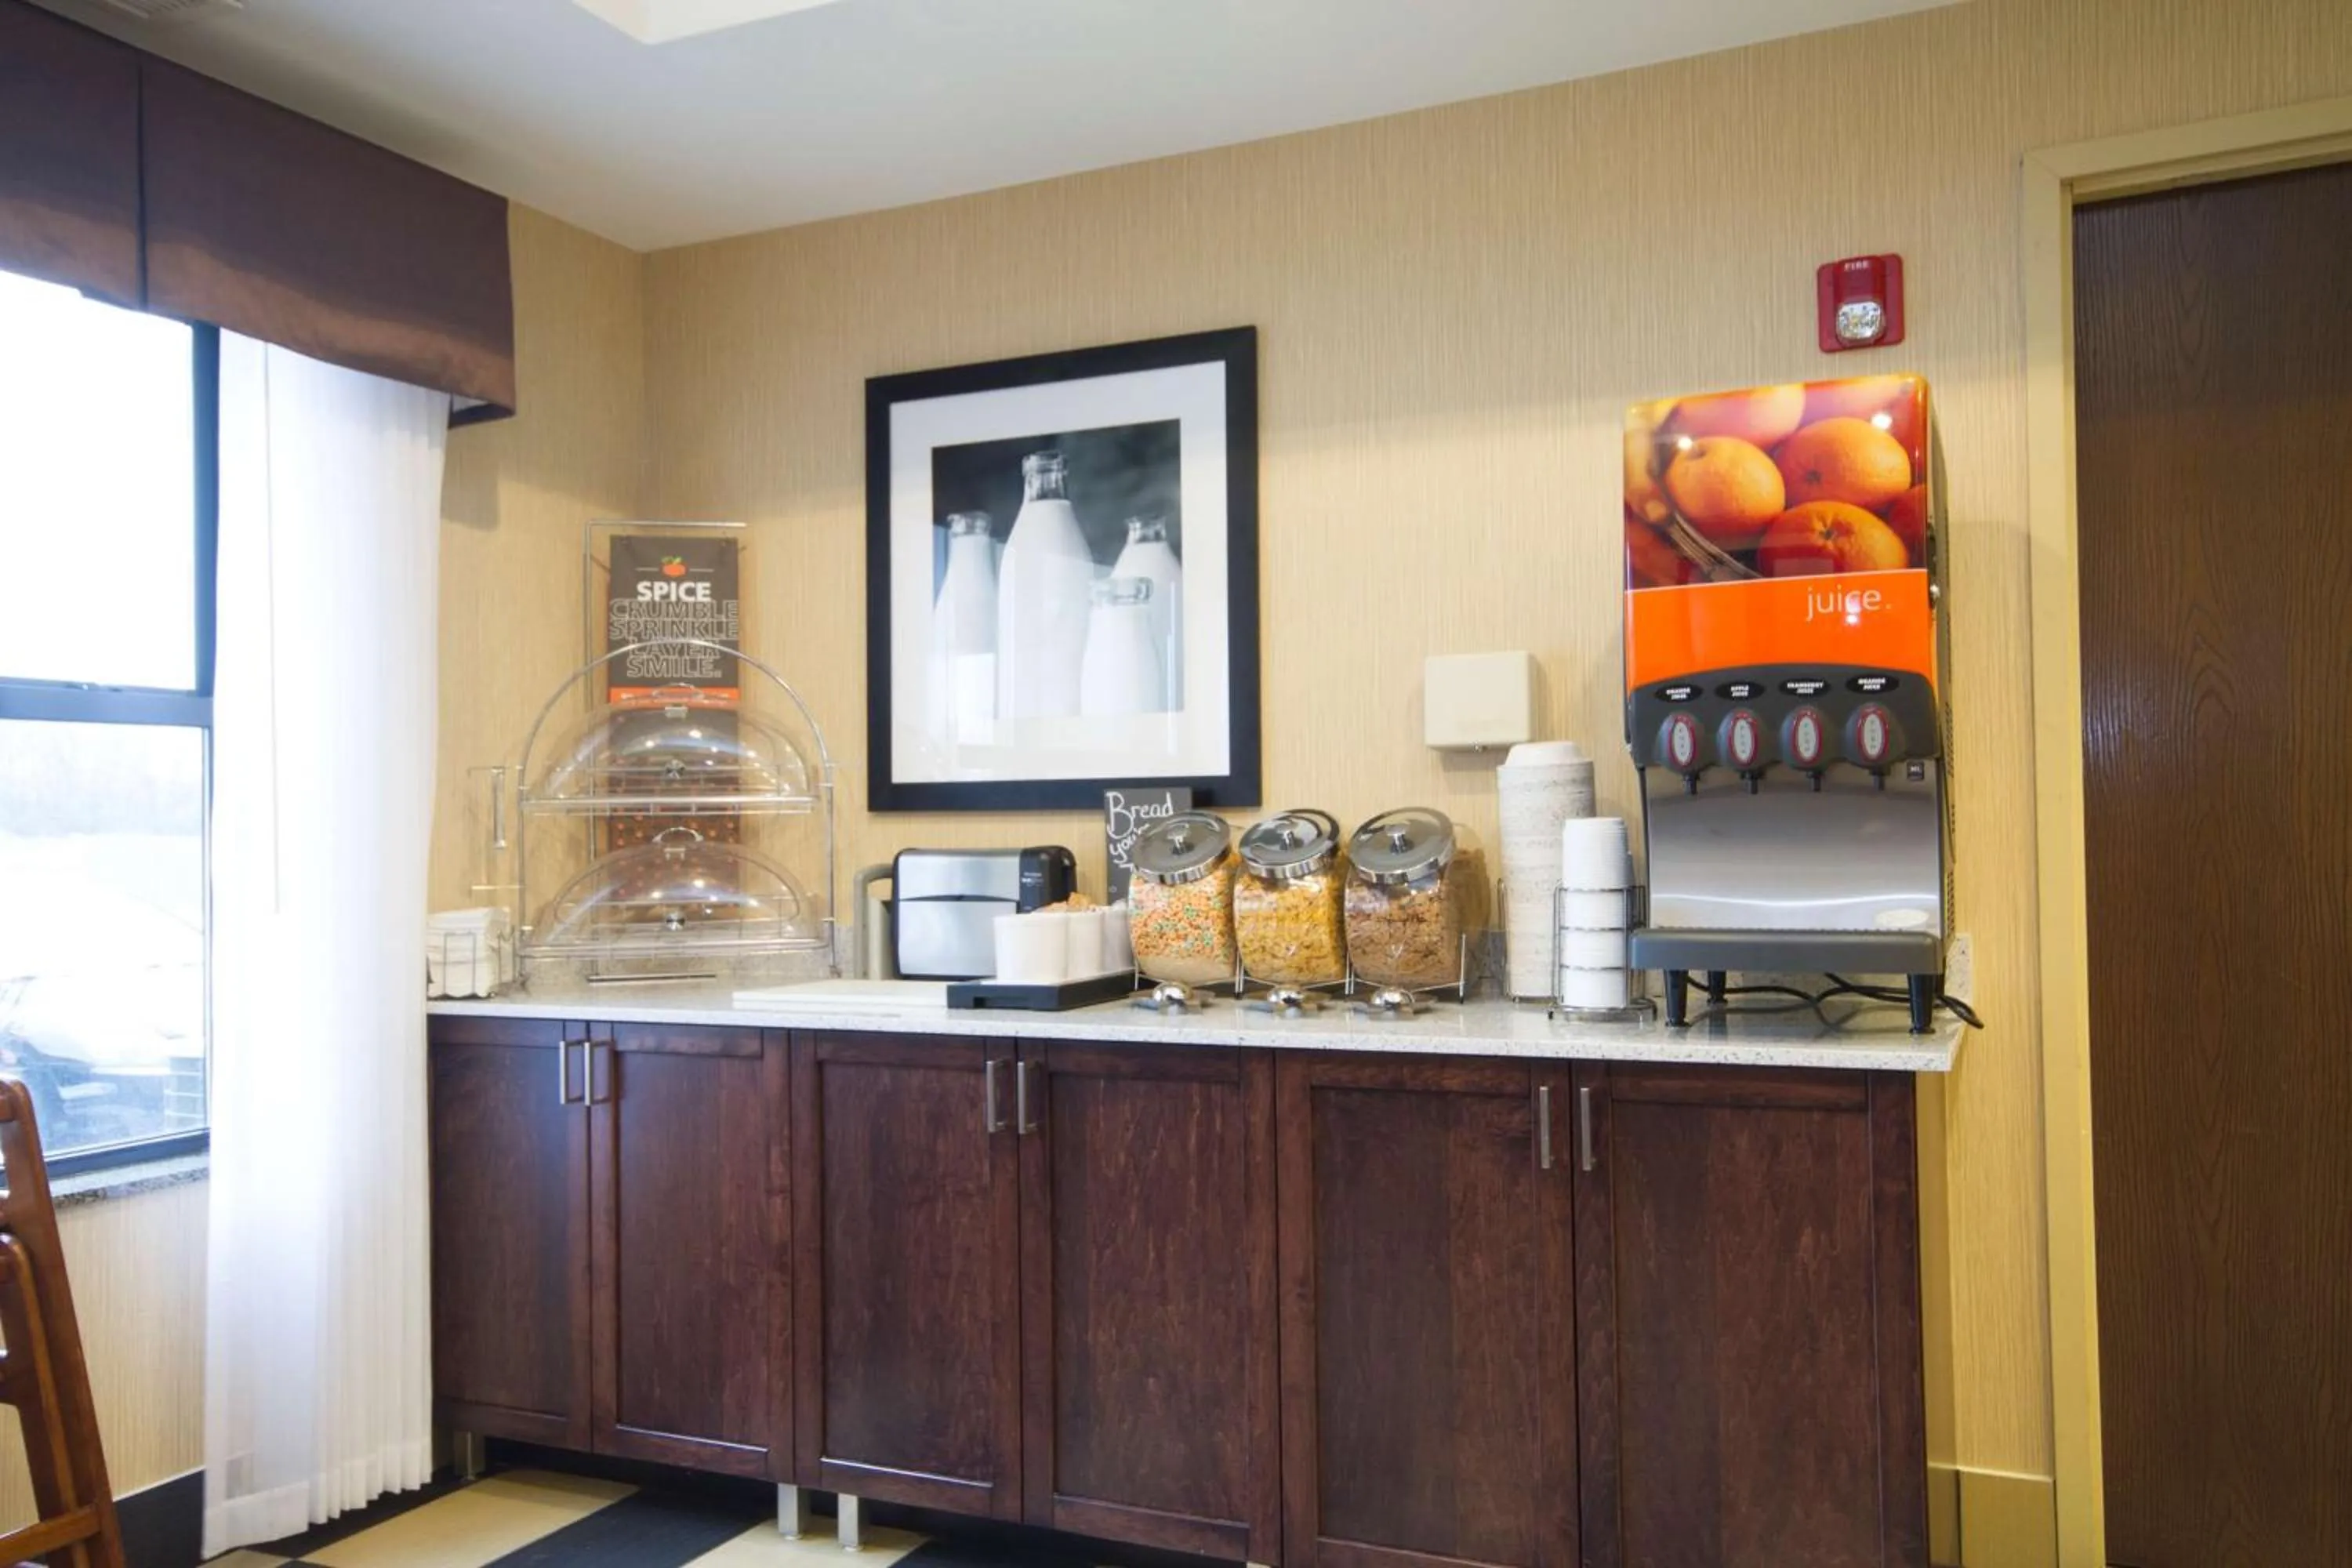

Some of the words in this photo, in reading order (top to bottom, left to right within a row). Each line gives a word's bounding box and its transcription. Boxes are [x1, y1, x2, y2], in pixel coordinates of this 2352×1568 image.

[636, 580, 712, 602] SPICE
[609, 597, 739, 620] CRUMBLE
[609, 618, 739, 641] SPRINKLE
[627, 637, 720, 659] LAYER
[1105, 791, 1174, 839] Bread
